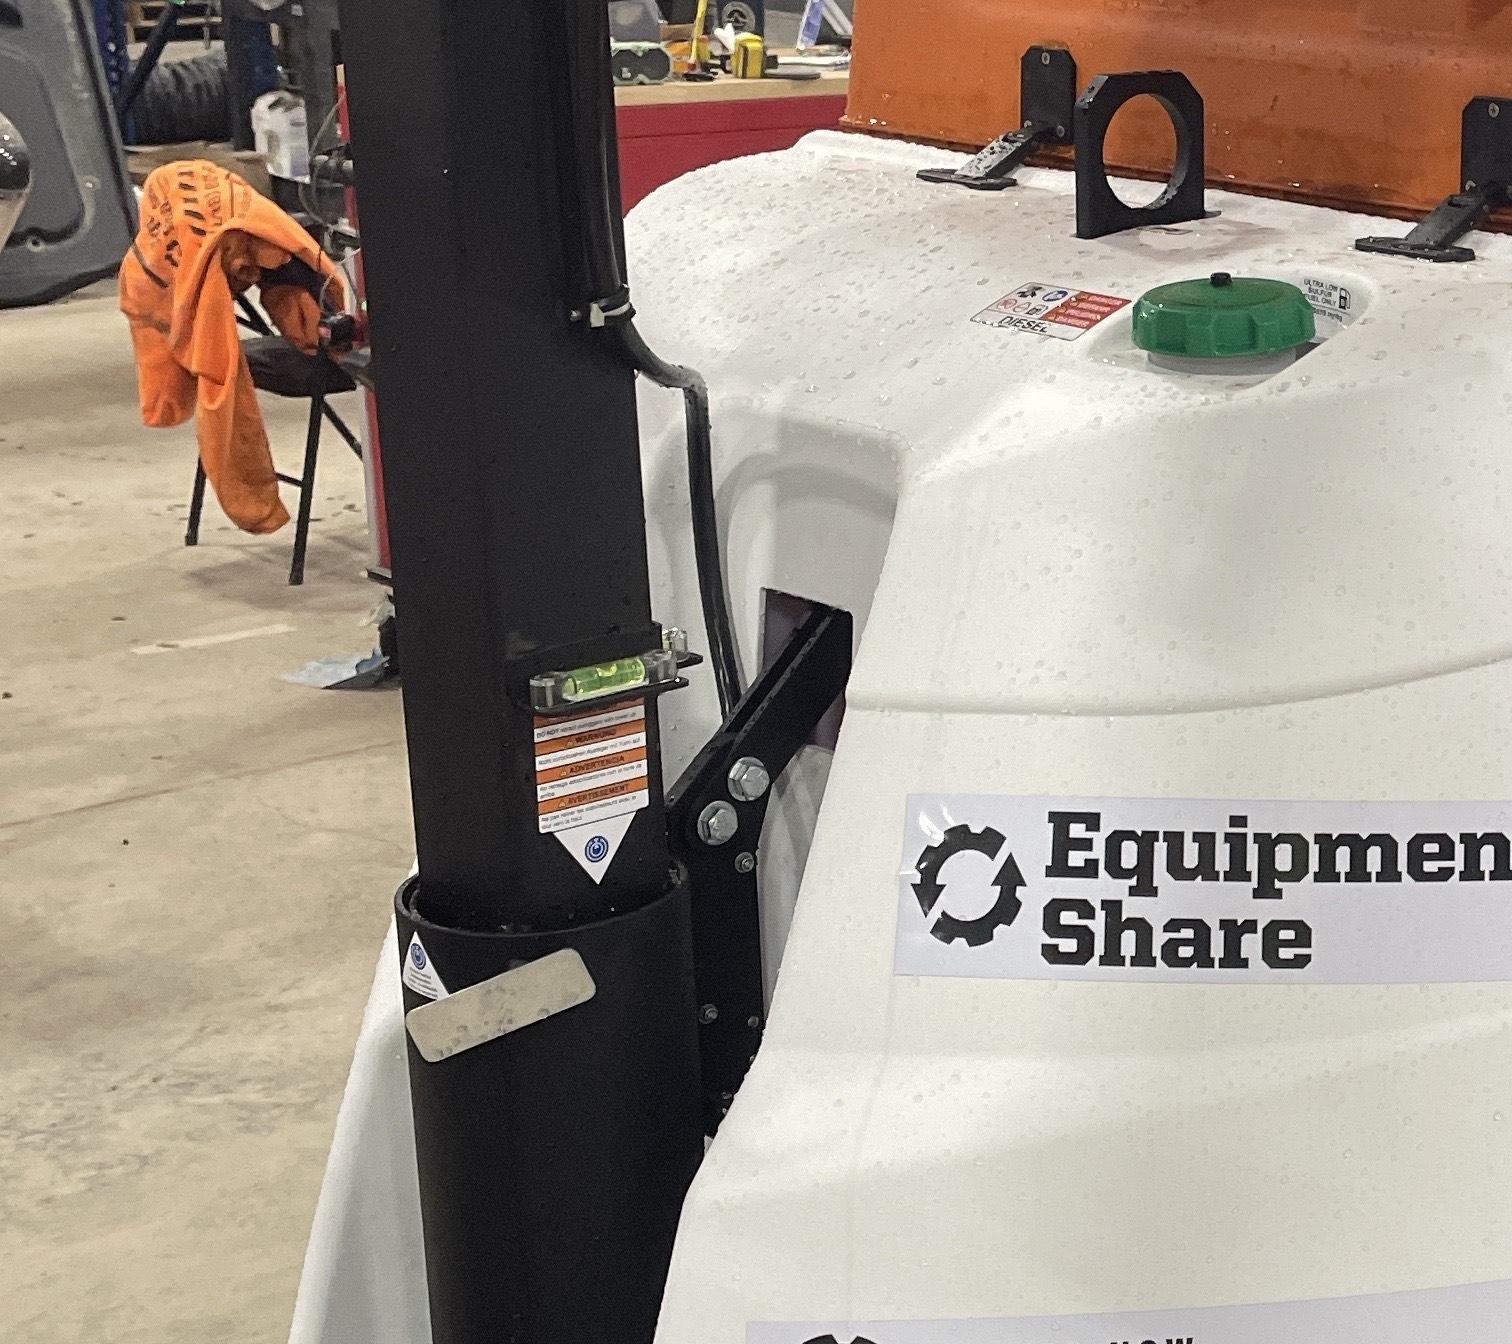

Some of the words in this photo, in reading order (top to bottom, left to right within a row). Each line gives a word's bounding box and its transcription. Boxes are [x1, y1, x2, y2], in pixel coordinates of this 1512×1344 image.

[1000, 316, 1048, 333] DIESEL
[569, 755, 625, 773] ADVERTENCIA
[1040, 897, 1313, 970] Share
